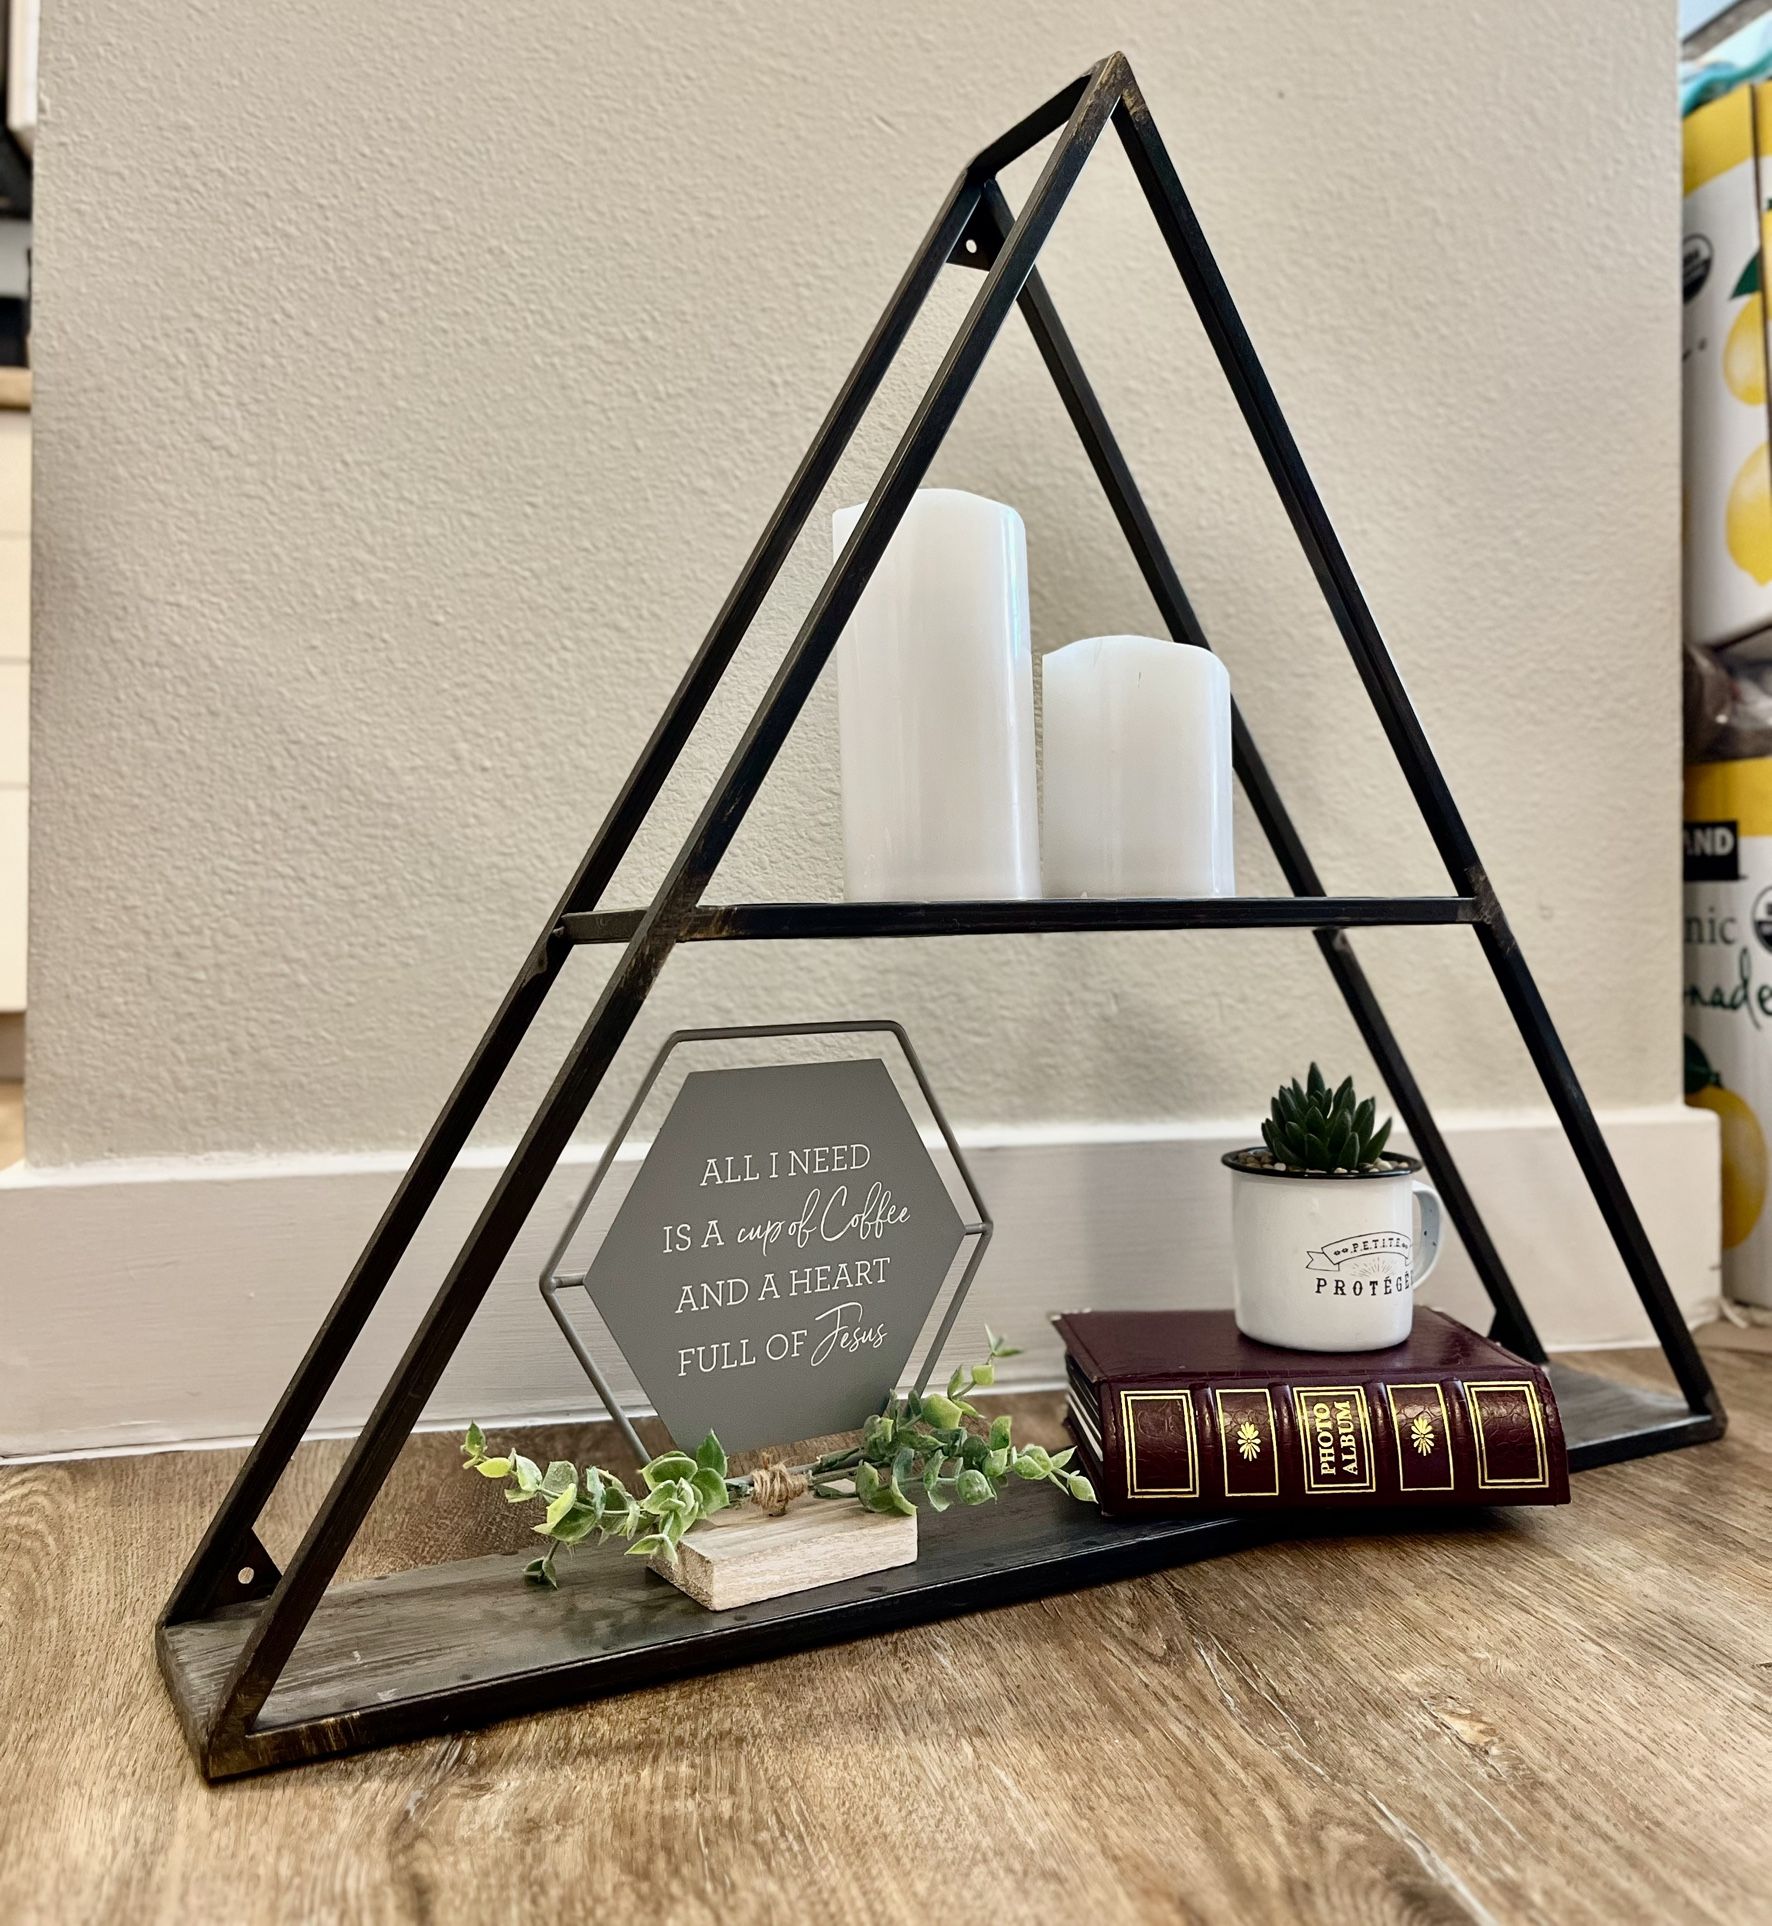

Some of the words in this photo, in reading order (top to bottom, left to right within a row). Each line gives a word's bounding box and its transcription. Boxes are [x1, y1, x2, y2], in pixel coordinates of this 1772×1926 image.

[700, 1154, 760, 1187] ALL
[769, 1151, 779, 1179] I
[788, 1143, 871, 1178] NEED
[662, 1223, 692, 1254] IS
[700, 1219, 725, 1249] A
[736, 1218, 786, 1257] cup
[788, 1188, 821, 1249] of
[820, 1181, 911, 1243] Coffee
[674, 1277, 750, 1314] AND
[758, 1272, 781, 1302] A
[788, 1256, 892, 1297] HEART
[677, 1338, 757, 1378] FULL
[765, 1329, 808, 1361] OF
[810, 1301, 888, 1368] Jesus
[1313, 1402, 1337, 1476] PHOTO
[1333, 1400, 1359, 1476] ALBUM
